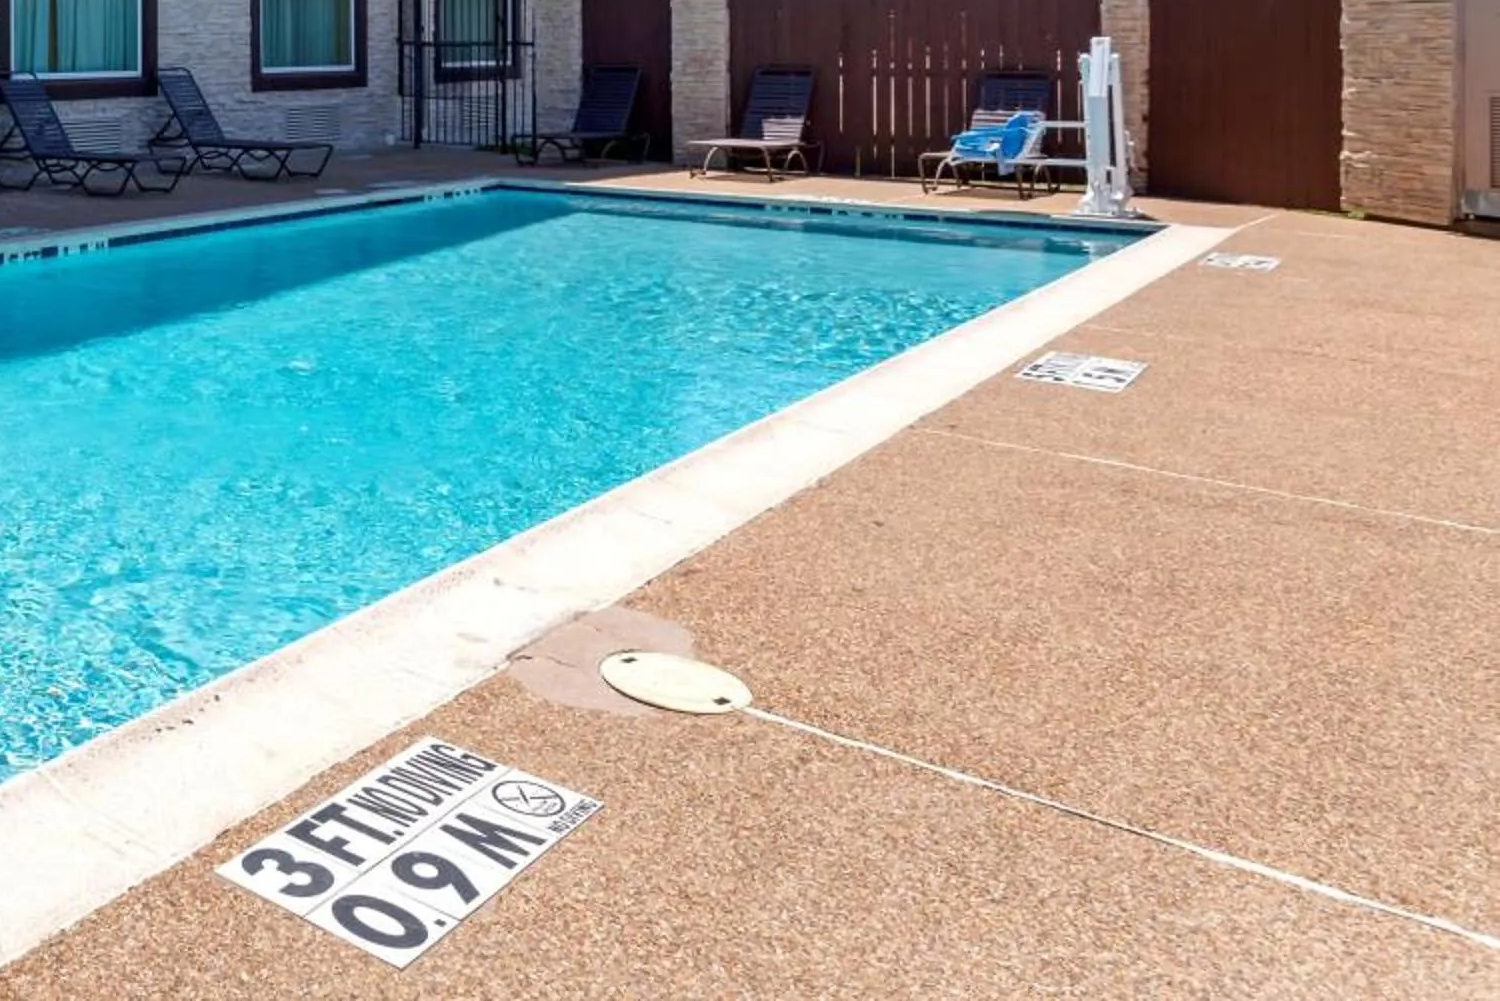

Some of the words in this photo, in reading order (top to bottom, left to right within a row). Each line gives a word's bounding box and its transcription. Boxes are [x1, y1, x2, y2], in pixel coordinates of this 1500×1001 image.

[376, 744, 498, 807] DIVING
[346, 787, 429, 828] NO
[241, 848, 335, 898] 3
[331, 851, 481, 949] 0.9
[439, 812, 549, 870] M
